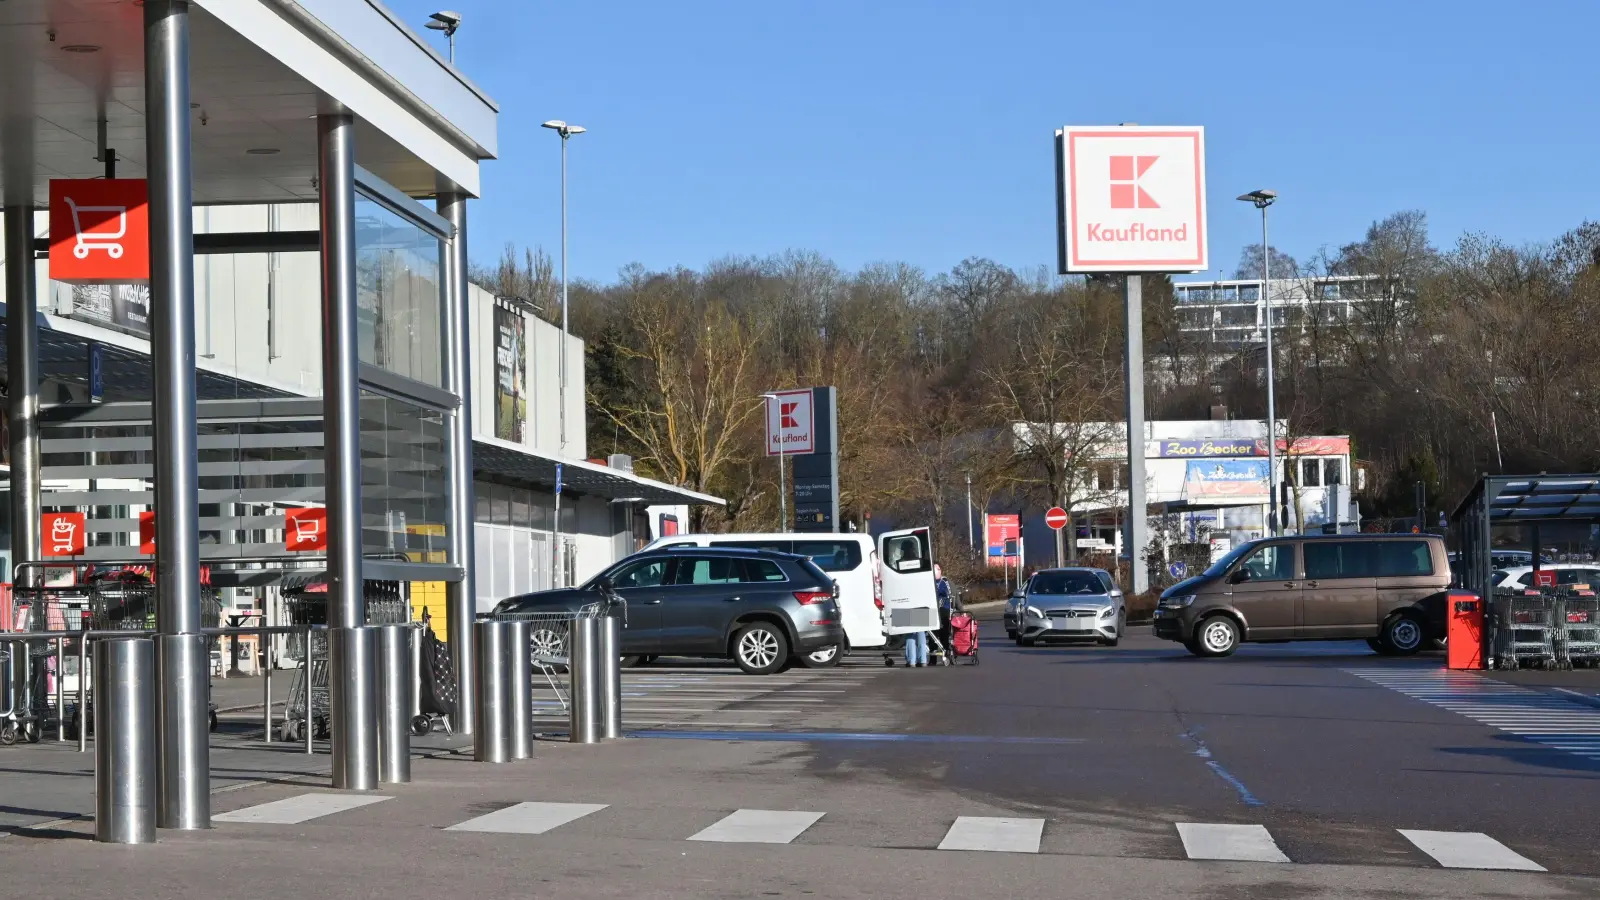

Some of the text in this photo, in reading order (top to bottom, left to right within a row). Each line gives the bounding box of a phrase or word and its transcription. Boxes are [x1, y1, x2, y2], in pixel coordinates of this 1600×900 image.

[1087, 222, 1187, 242] Kaufland
[1166, 441, 1252, 455] Zoo Becker
